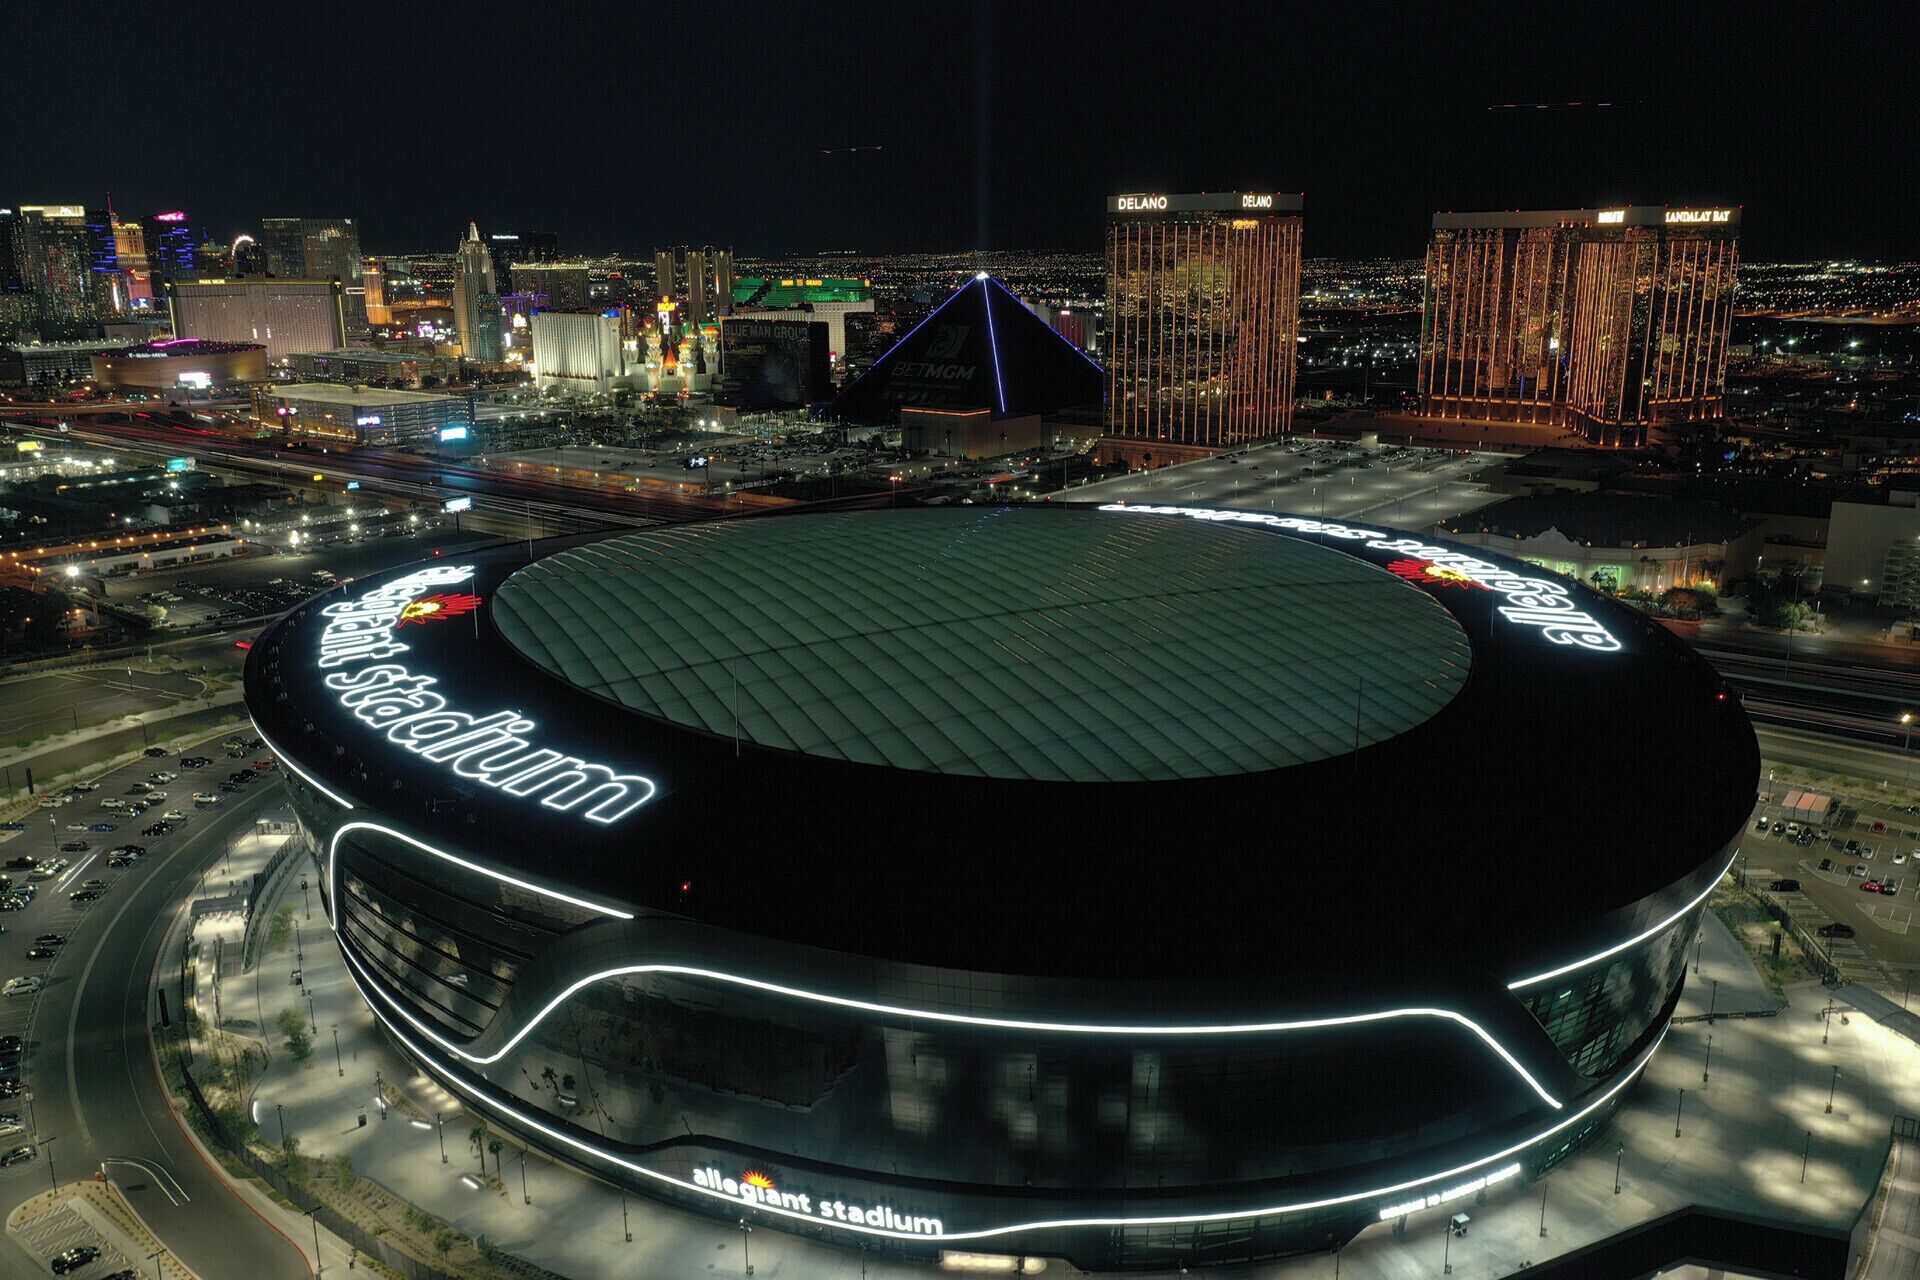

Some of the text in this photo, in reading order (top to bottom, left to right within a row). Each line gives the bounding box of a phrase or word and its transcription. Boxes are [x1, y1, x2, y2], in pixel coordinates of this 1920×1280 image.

[1118, 197, 1168, 210] DELANO
[1242, 195, 1272, 208] DELANO
[1713, 210, 1730, 221] BAY
[724, 323, 746, 336] BLUE
[750, 325, 771, 338] MAN
[892, 362, 976, 380] BETMGM
[326, 664, 655, 824] stadium
[693, 1167, 944, 1236] allegiant stadium
